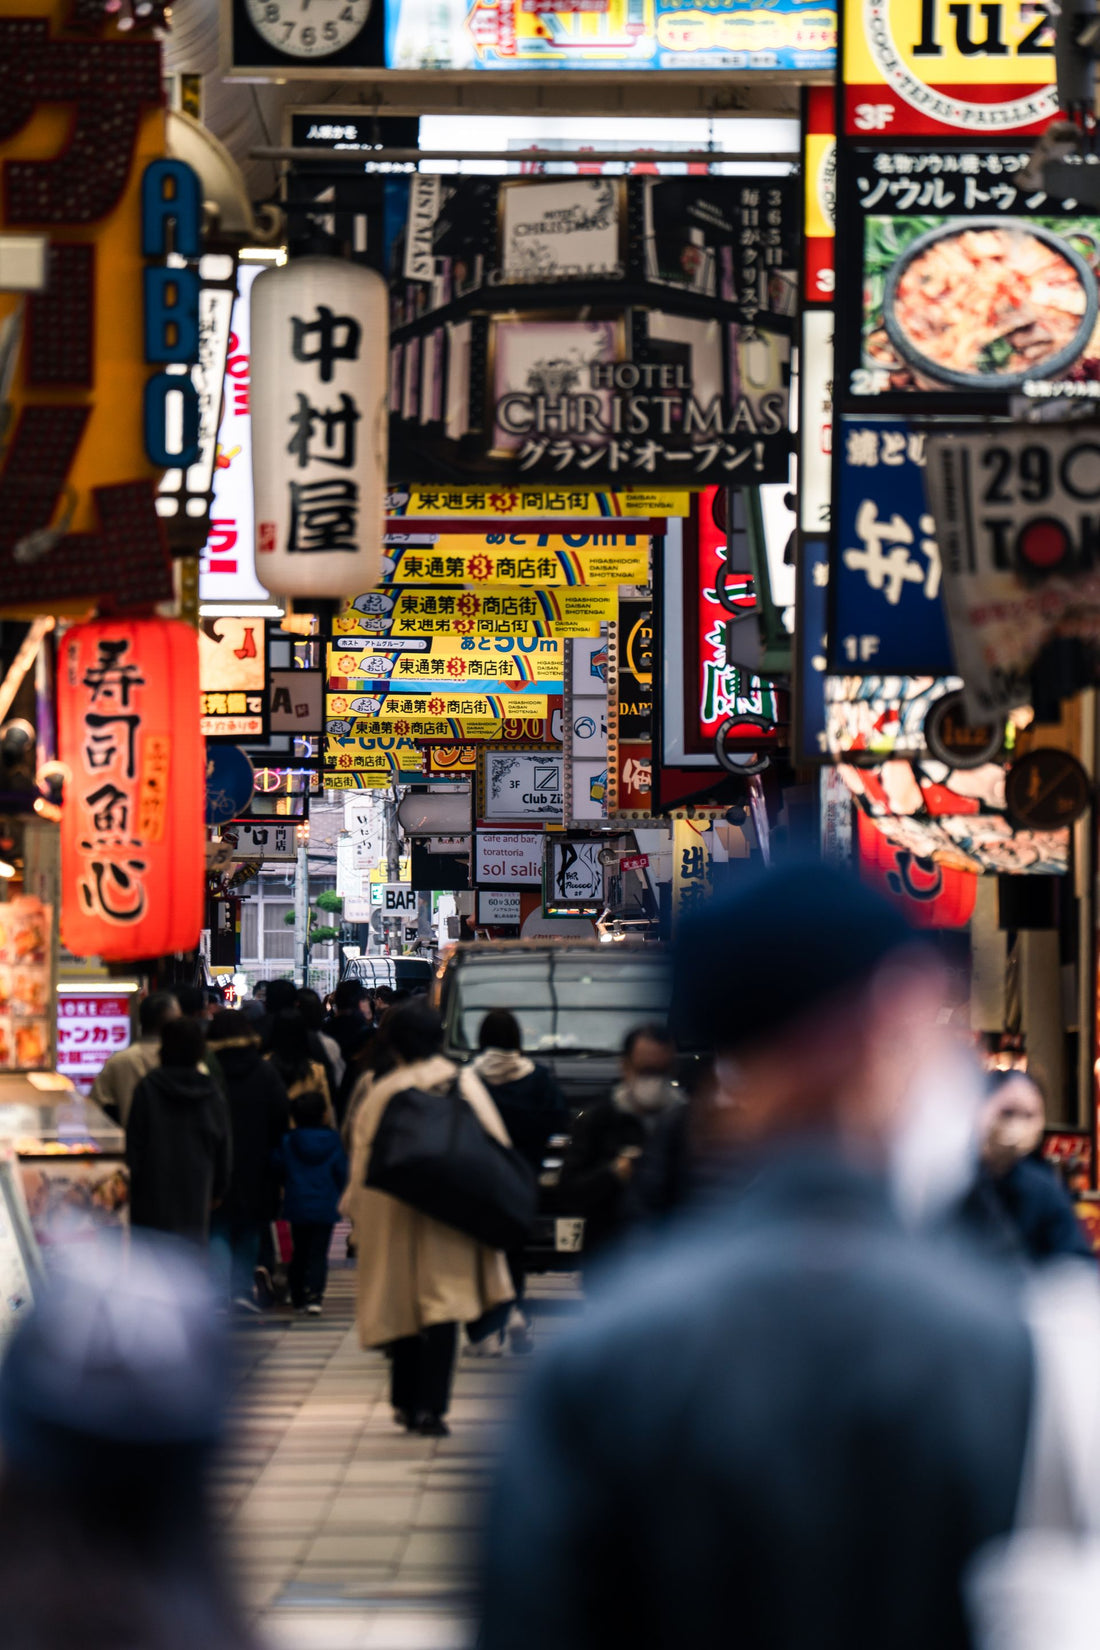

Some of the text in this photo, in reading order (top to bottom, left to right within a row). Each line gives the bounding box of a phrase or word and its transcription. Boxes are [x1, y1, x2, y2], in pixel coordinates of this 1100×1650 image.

[854, 103, 895, 130] 3F
[857, 176, 956, 210] ソウル
[591, 363, 693, 390] HOTEL
[497, 393, 783, 436] CHRISTMAS
[287, 304, 362, 554] 中村屋
[403, 556, 557, 579] 東通第3商店街
[400, 595, 537, 616] 東通第3商店街
[399, 657, 514, 676] 東通第3商店街
[385, 698, 488, 715] 東通第3商店街
[355, 721, 448, 735] 東通第3商店街
[509, 780, 520, 789] 3F
[522, 793, 548, 804] Club
[276, 824, 287, 852] 門店
[482, 834, 501, 843] cafe
[502, 834, 519, 843] and
[483, 847, 524, 857] torattoria
[482, 860, 509, 876] sol
[385, 890, 417, 910] BAR
